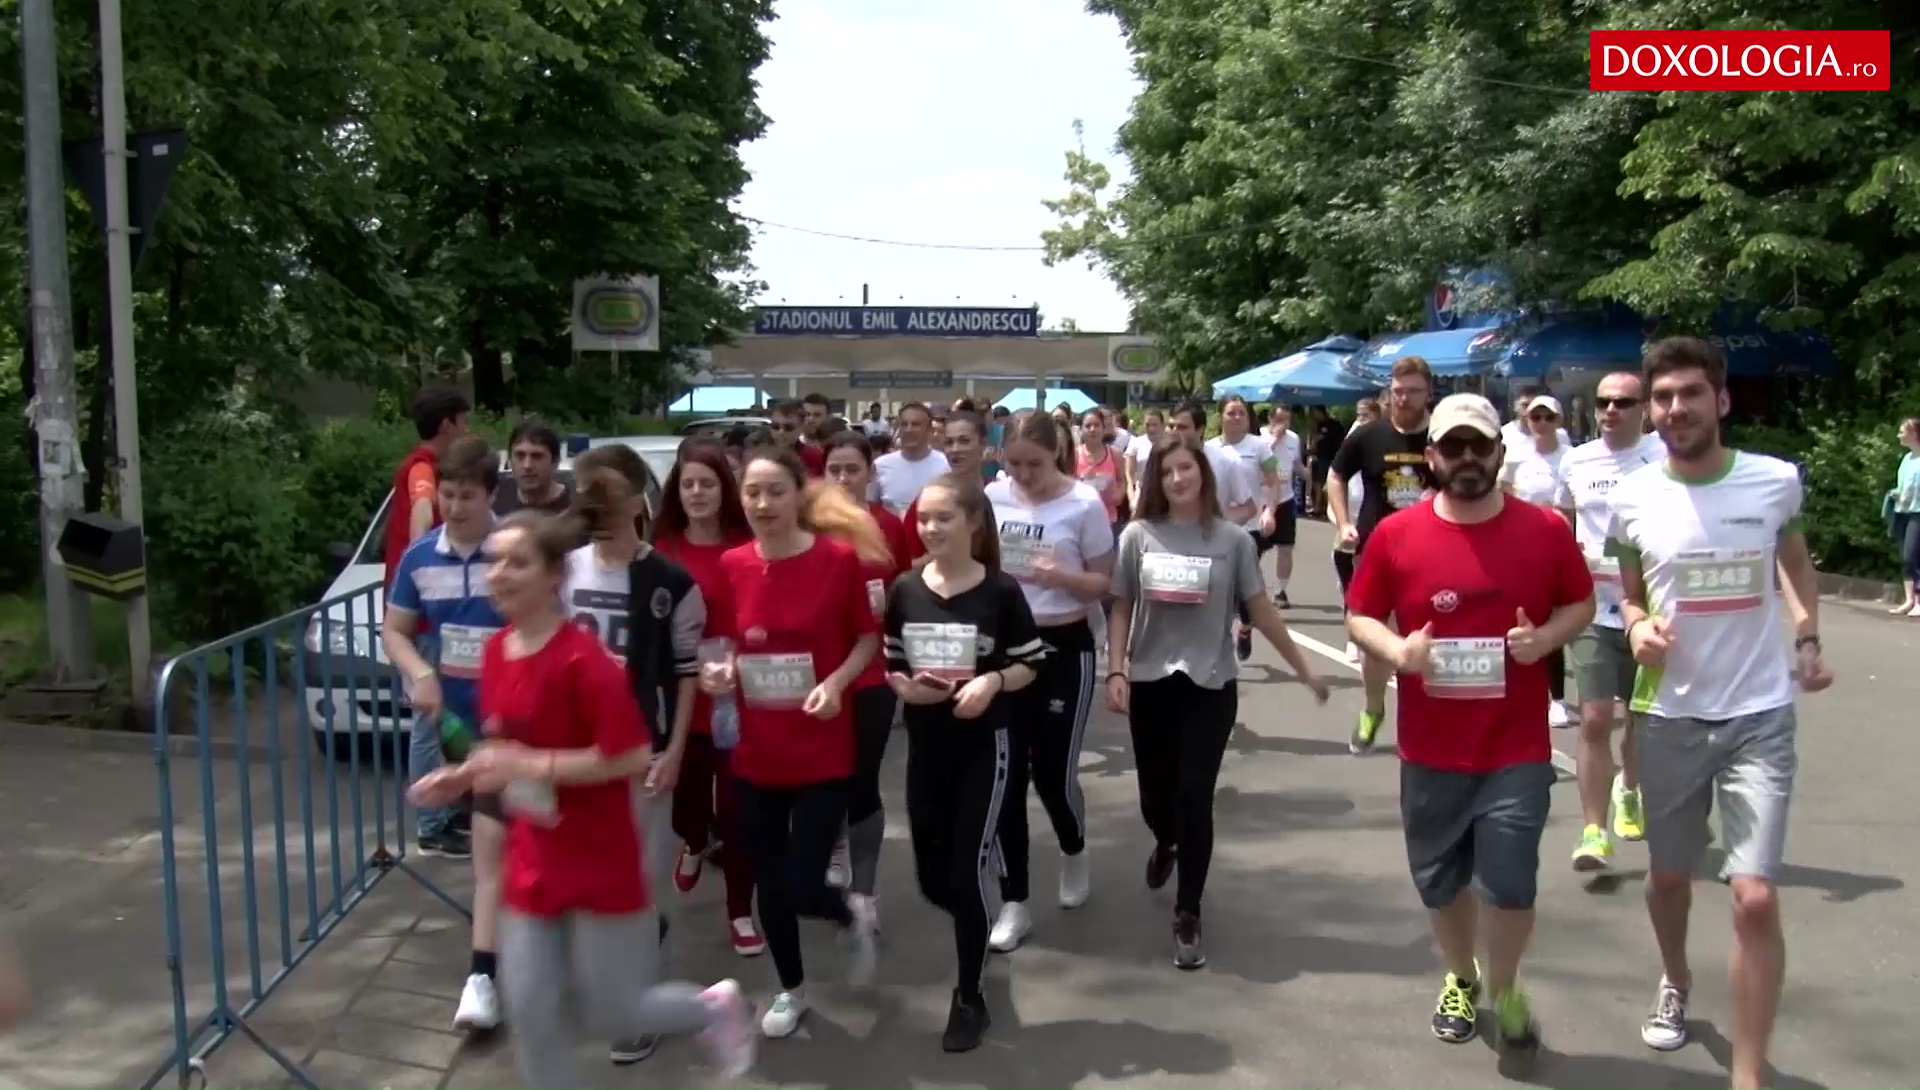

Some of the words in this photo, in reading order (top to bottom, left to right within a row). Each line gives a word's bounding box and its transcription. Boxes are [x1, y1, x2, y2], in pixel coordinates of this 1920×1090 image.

[762, 310, 852, 330] STADIONUL
[862, 311, 898, 330] EMIL
[907, 311, 1031, 332] ALEXANDRESCU
[1709, 333, 1768, 352] epsi
